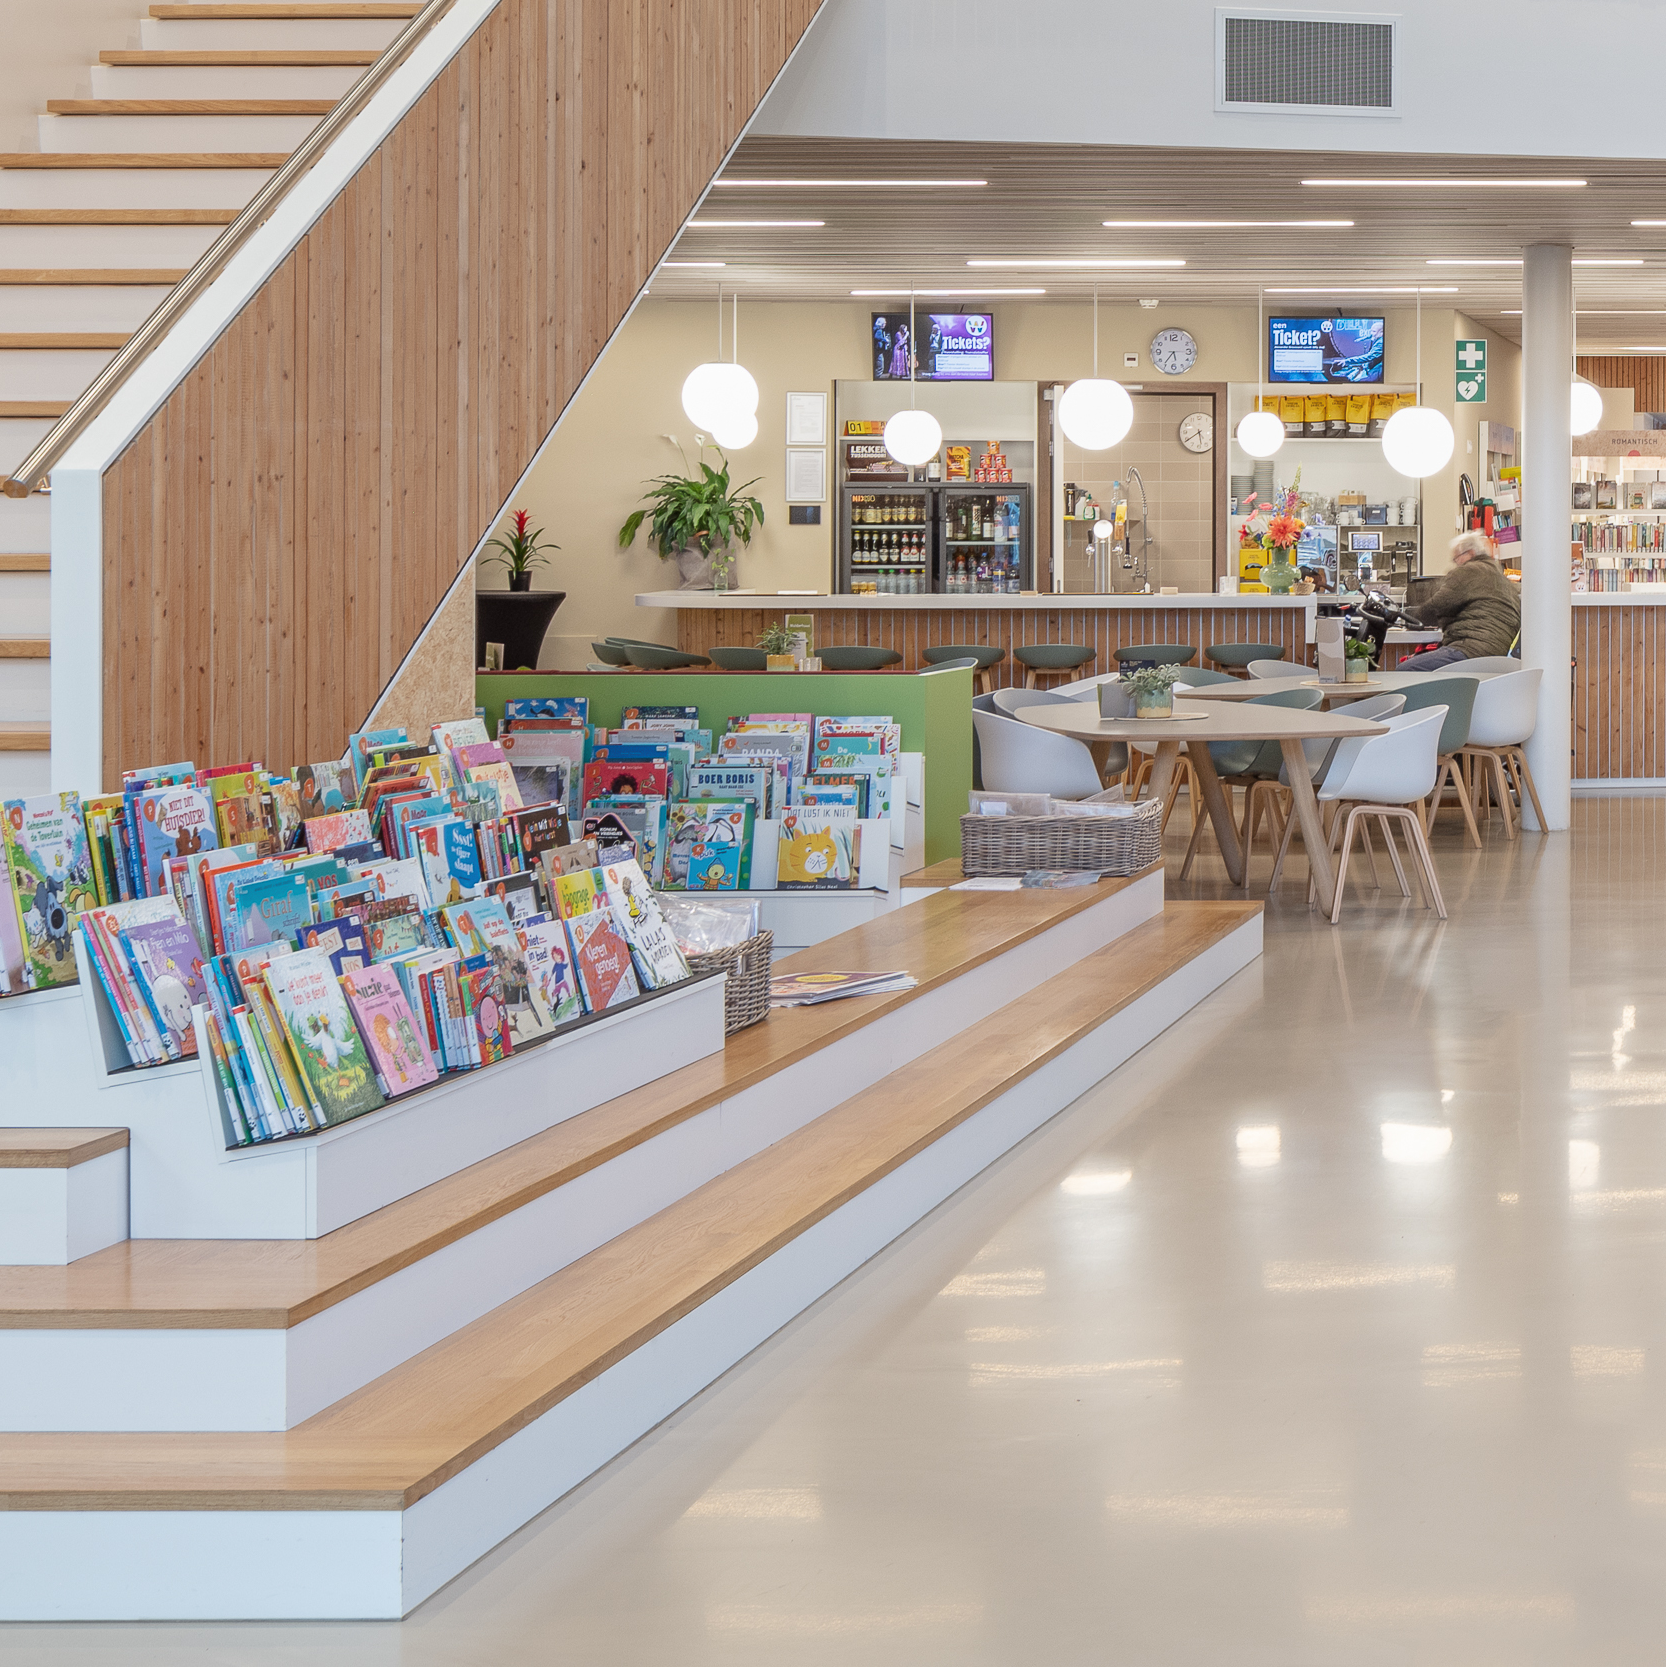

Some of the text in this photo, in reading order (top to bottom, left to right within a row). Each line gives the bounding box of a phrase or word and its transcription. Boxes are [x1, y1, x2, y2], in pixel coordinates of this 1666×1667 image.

[942, 336, 990, 350] Tickets?
[1273, 330, 1321, 345] Ticket?
[837, 746, 848, 754] De
[247, 779, 253, 789] S
[698, 773, 755, 784] BOER BORIS
[813, 776, 856, 786] ELMER
[147, 805, 153, 816] P
[168, 795, 194, 812] NIET DIT
[14, 812, 21, 823] N
[230, 810, 236, 820] S
[803, 808, 821, 818] LUST
[823, 808, 831, 818] IK
[833, 808, 850, 818] NIET
[26, 818, 64, 831] Geheimen van
[164, 809, 206, 833] HUISDIER!
[31, 833, 38, 842] de
[452, 828, 474, 847] Ssst!
[453, 857, 474, 874] slaapt
[260, 891, 294, 920] Giraf
[166, 936, 174, 947] en
[173, 931, 189, 945] Milo
[375, 933, 381, 944] S
[526, 933, 540, 947] niet
[527, 946, 548, 963] in bad!
[585, 941, 608, 963] Kleren
[595, 953, 621, 979] genoeg!
[295, 978, 308, 990] kunt
[309, 972, 324, 985] meer
